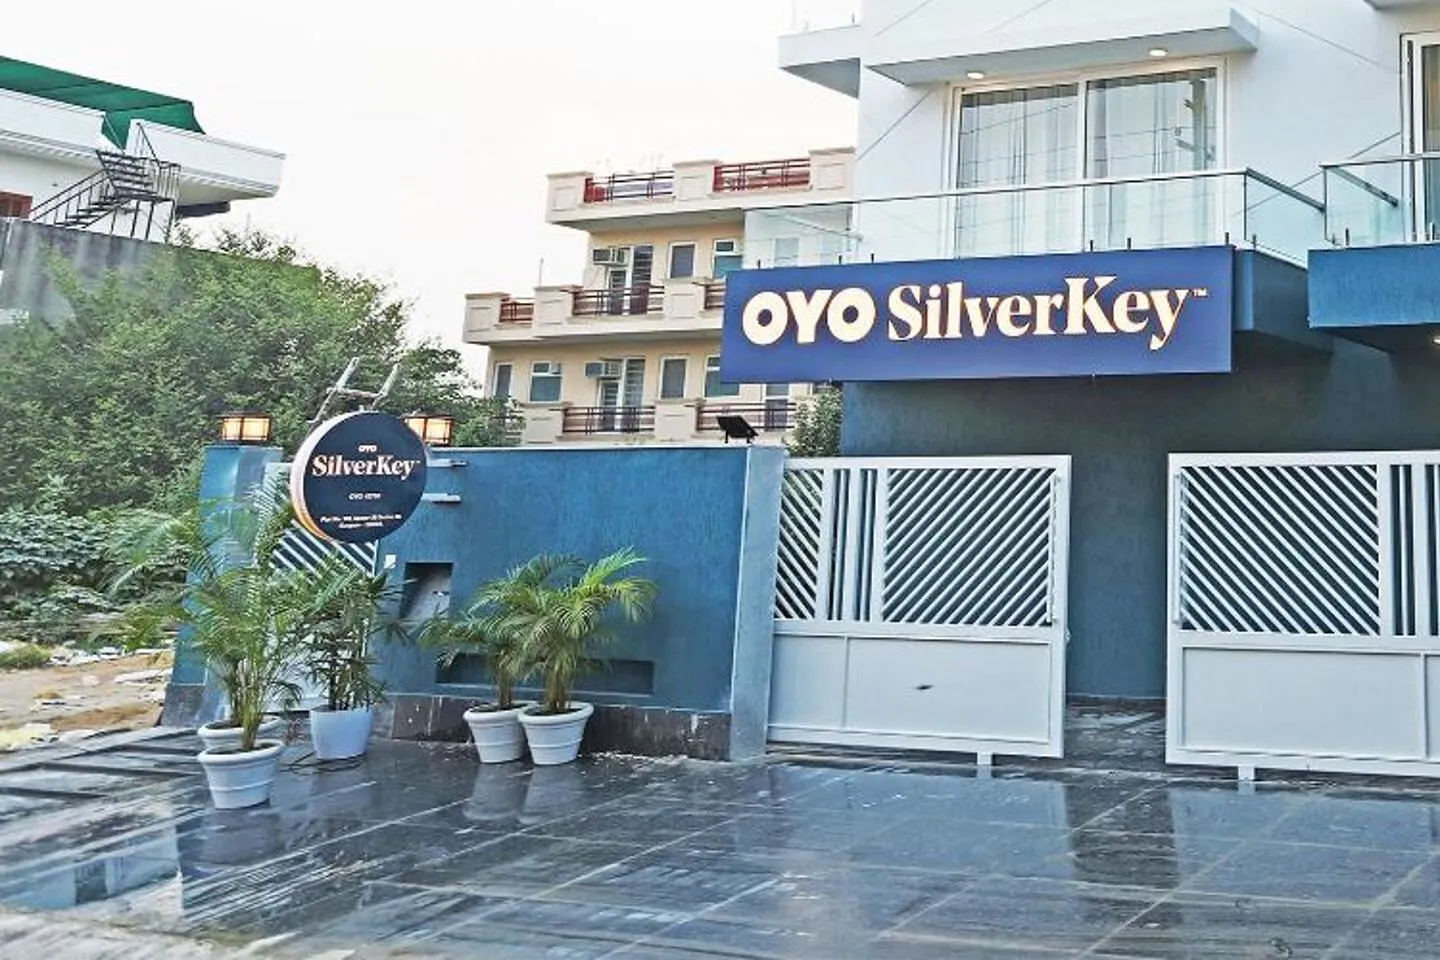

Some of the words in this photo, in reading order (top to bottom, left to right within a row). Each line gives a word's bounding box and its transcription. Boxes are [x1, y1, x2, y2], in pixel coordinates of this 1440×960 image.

[742, 287, 876, 345] OYO
[888, 275, 1190, 351] SilverKey
[358, 444, 378, 453] OYO
[312, 454, 416, 480] SilverKey
